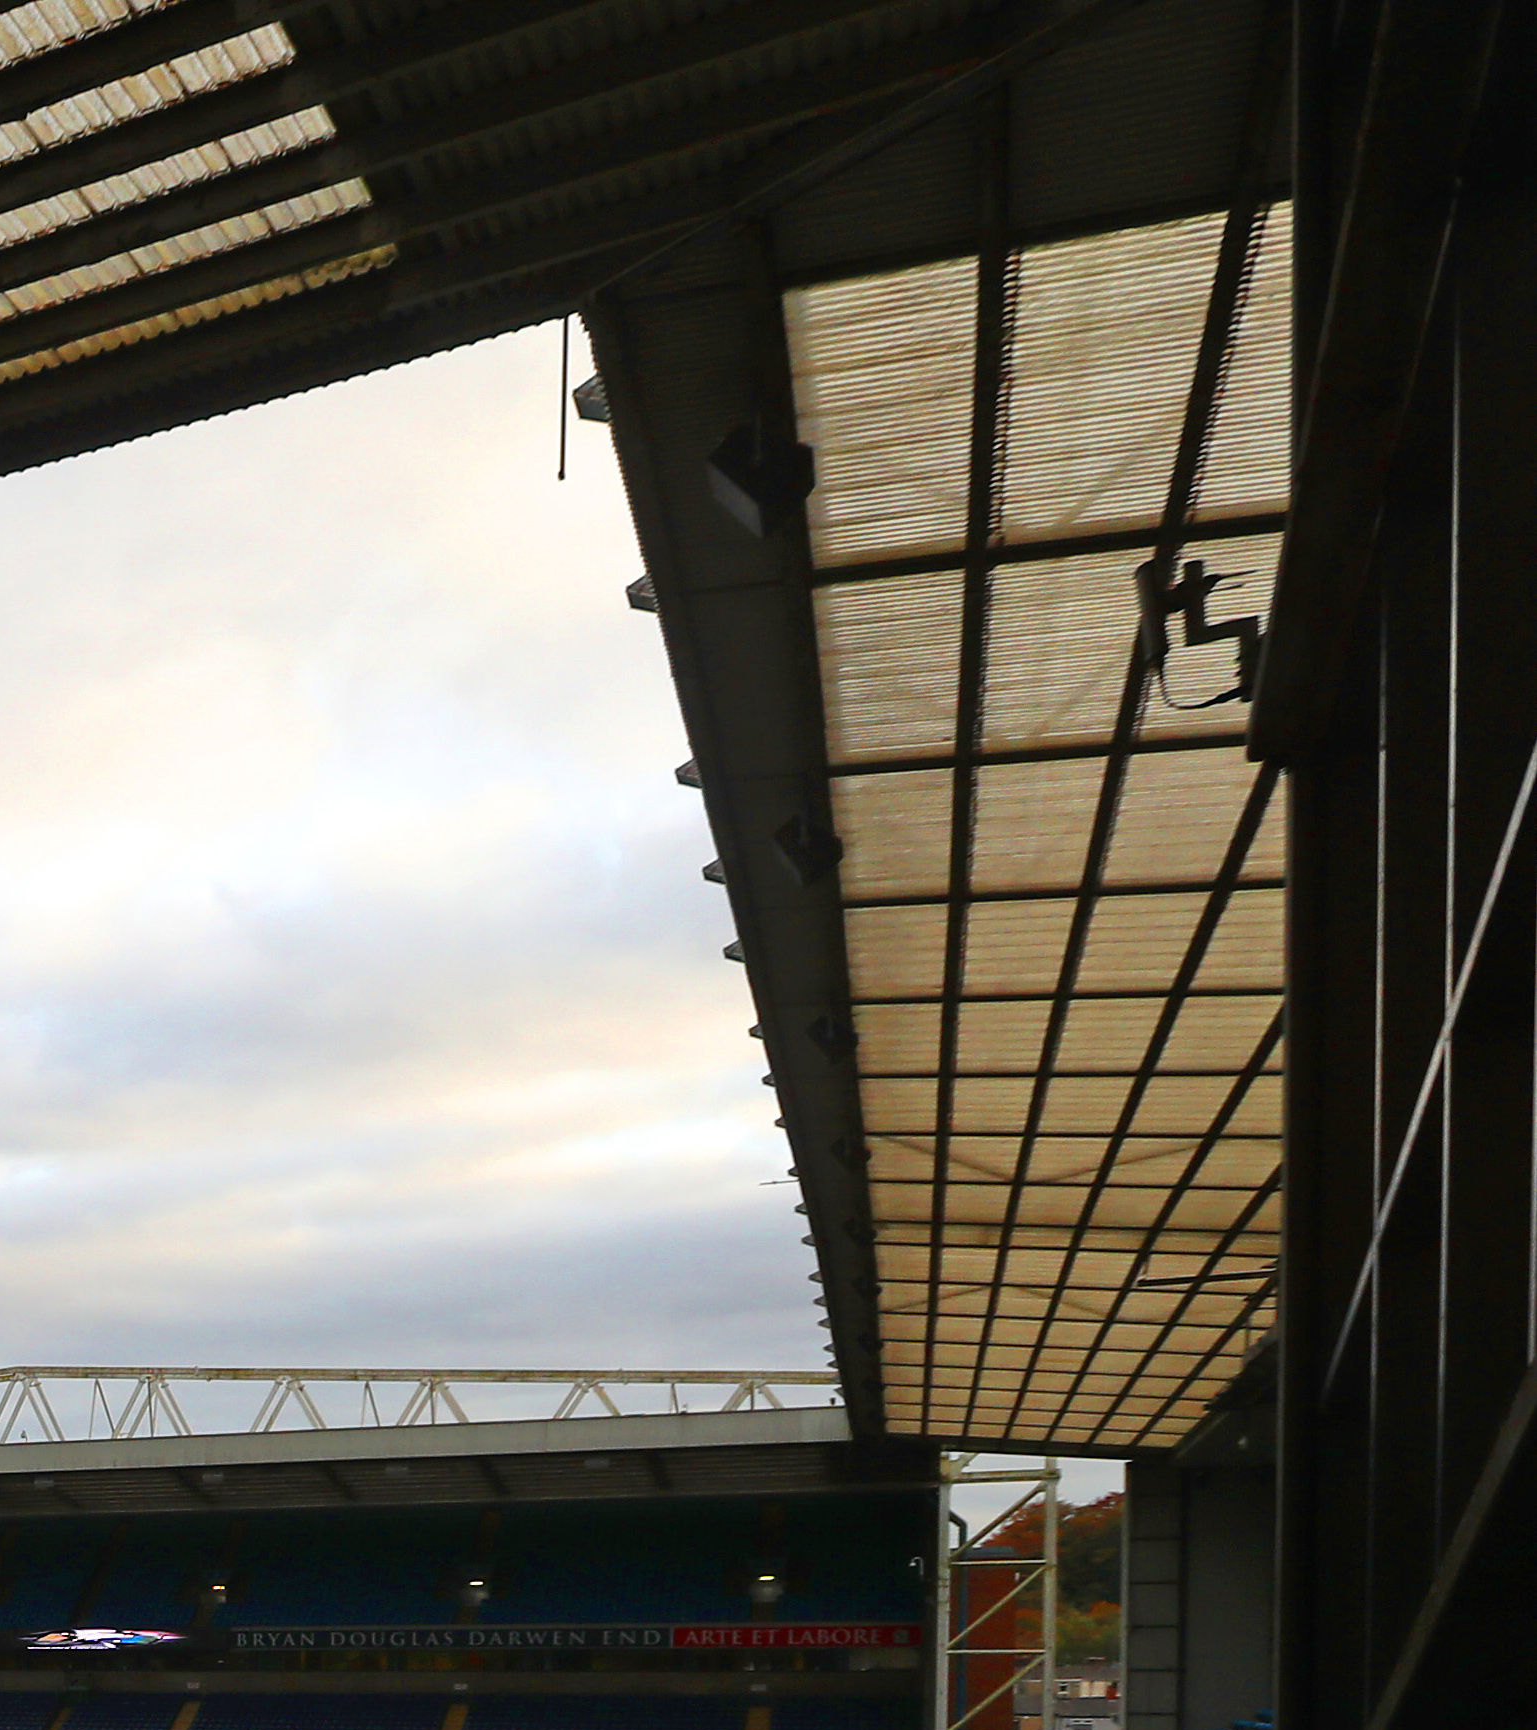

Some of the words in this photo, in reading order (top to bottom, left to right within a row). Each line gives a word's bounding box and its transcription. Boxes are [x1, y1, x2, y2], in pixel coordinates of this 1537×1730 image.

[236, 1632, 315, 1647] BRYAN
[330, 1631, 454, 1647] DOUGLAS
[469, 1630, 587, 1646] DARWEN
[602, 1629, 662, 1646] END
[685, 1628, 748, 1645] ARTE
[752, 1628, 780, 1645] ET
[787, 1628, 880, 1645] LABORE
